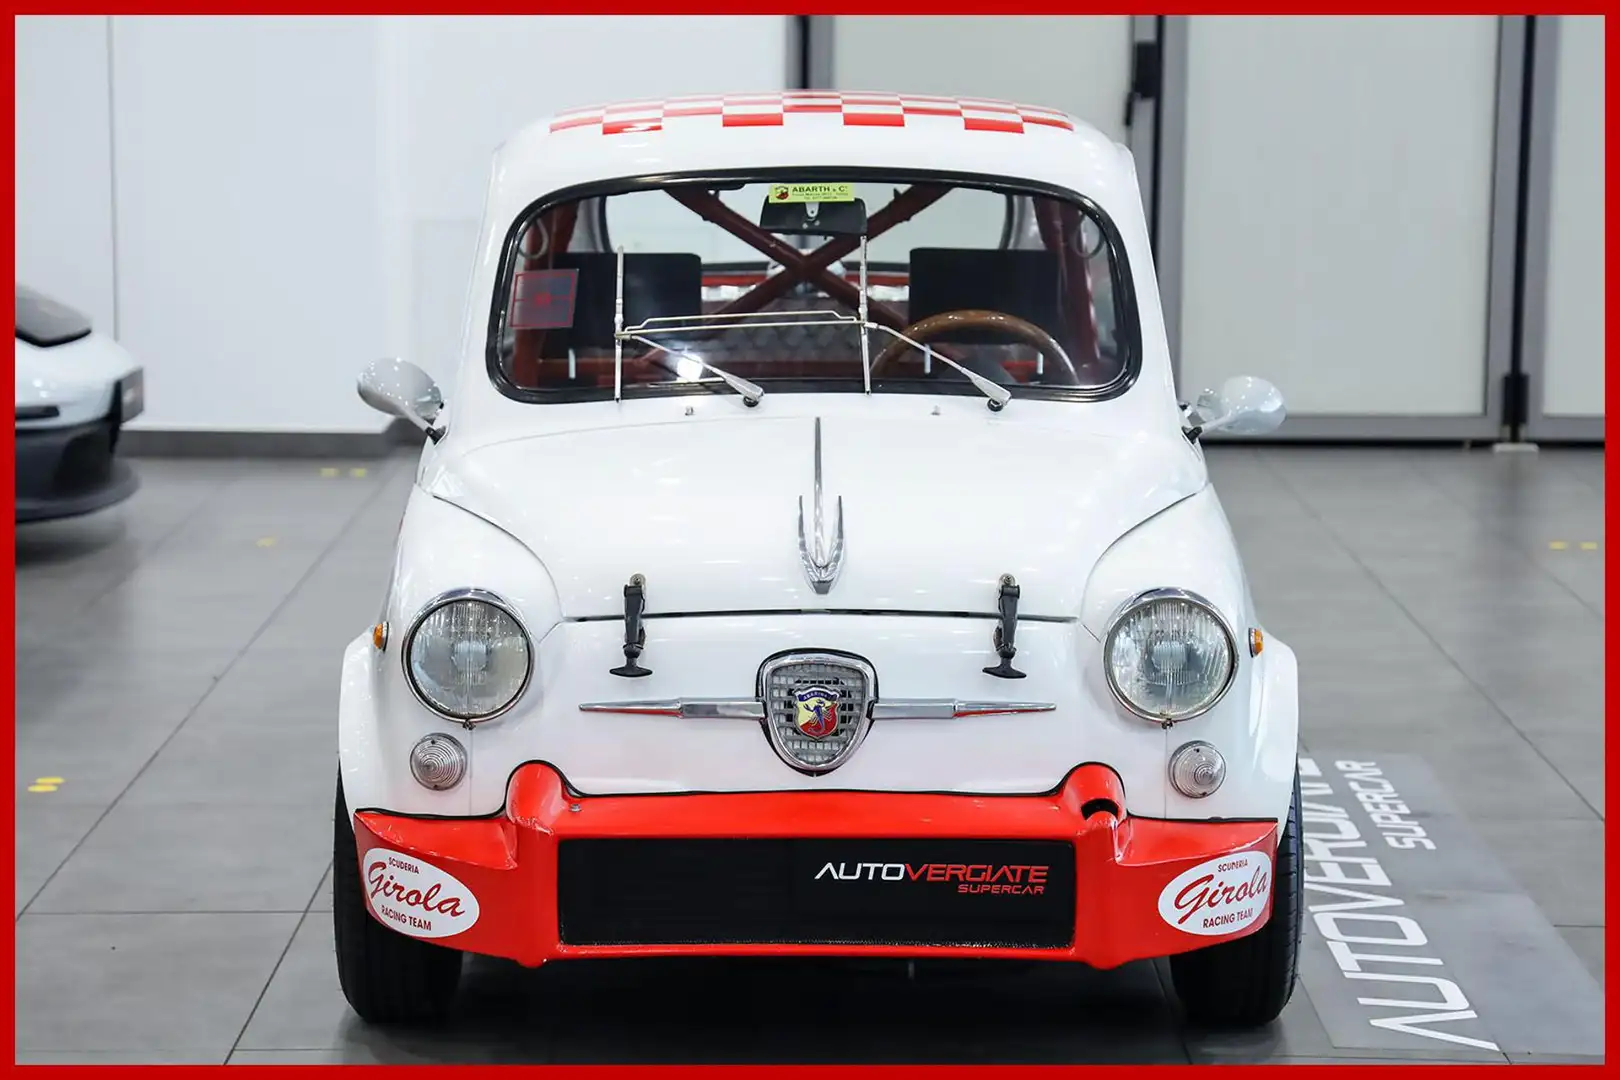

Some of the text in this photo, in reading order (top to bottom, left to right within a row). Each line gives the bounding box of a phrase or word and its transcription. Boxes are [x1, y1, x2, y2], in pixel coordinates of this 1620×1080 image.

[1334, 759, 1437, 850] SUPERCAR
[389, 857, 419, 874] SCUDERIA
[814, 862, 1049, 884] AUTOVERGIATE
[1218, 859, 1248, 872] SCUDERIA
[368, 861, 465, 917] Girola
[957, 884, 1045, 895] SUPERCAR
[1174, 865, 1267, 925] Girola
[381, 905, 432, 931] RACING TEAM
[1203, 908, 1253, 928] RACING TEAM
